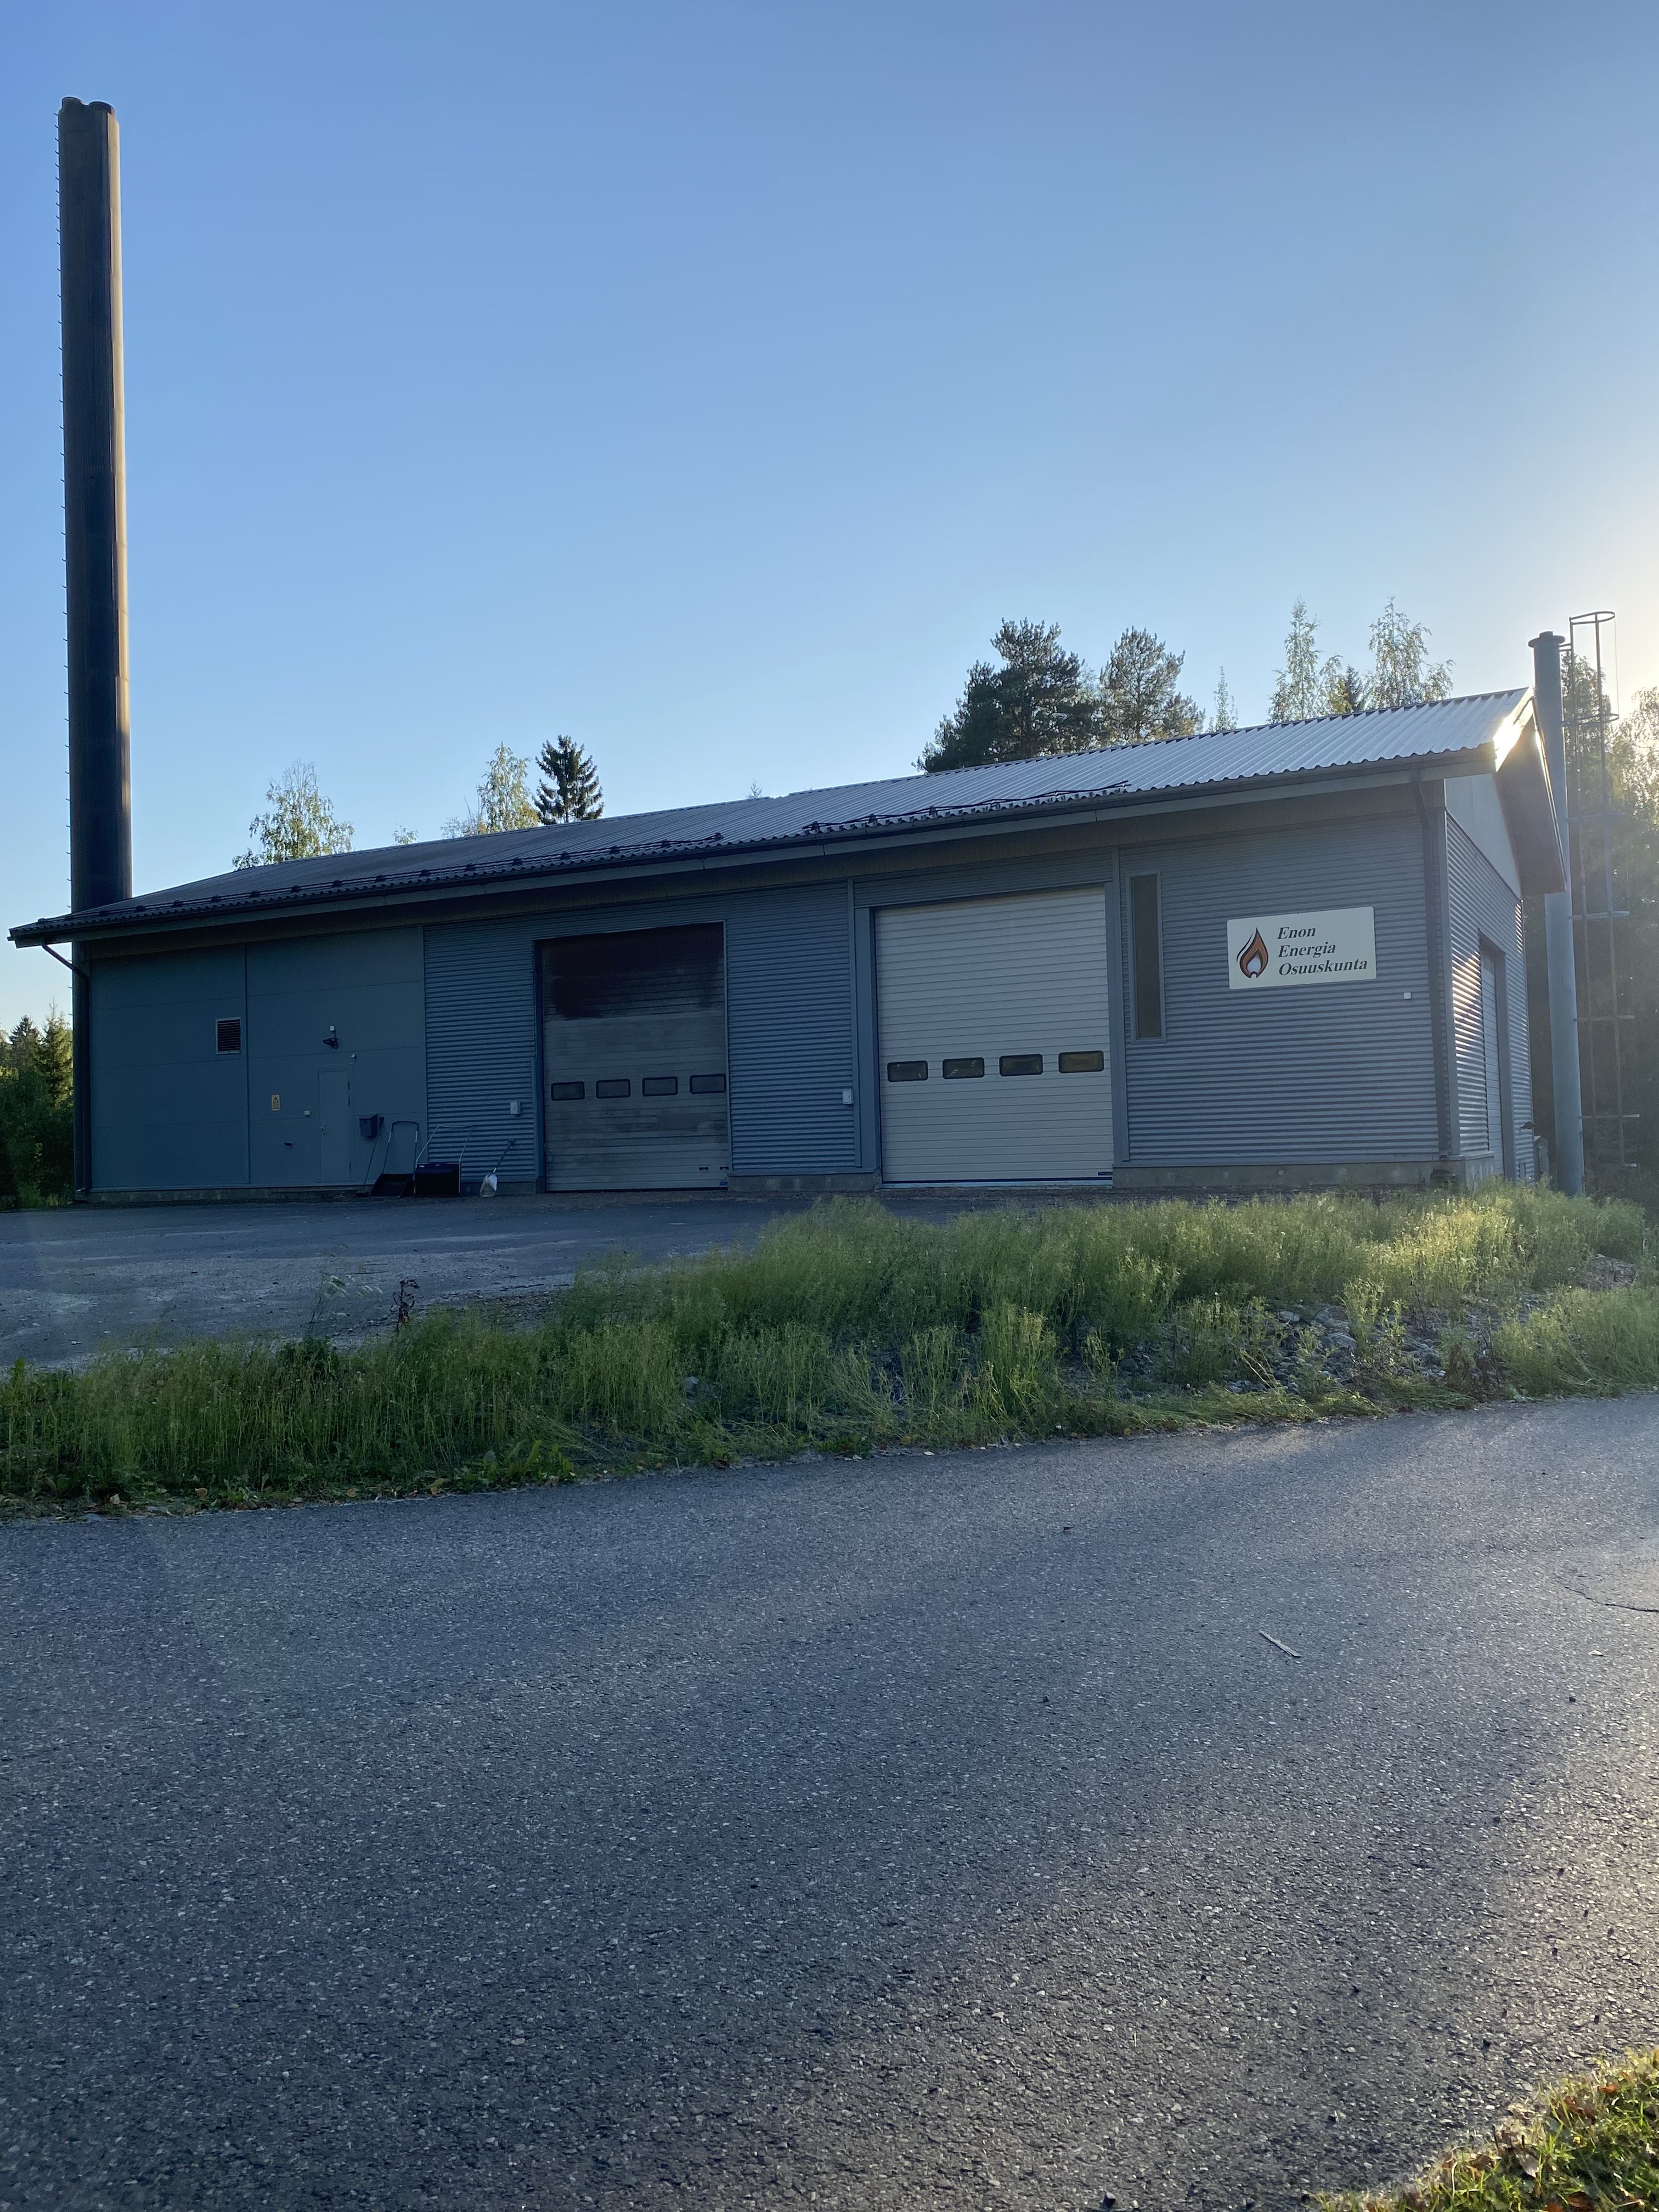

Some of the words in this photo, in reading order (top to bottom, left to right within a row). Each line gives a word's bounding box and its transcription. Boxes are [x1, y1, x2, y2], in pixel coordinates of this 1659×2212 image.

[1277, 927, 1316, 940] Enon
[1278, 942, 1336, 958] Energia
[1279, 959, 1368, 976] Osuuskunta
